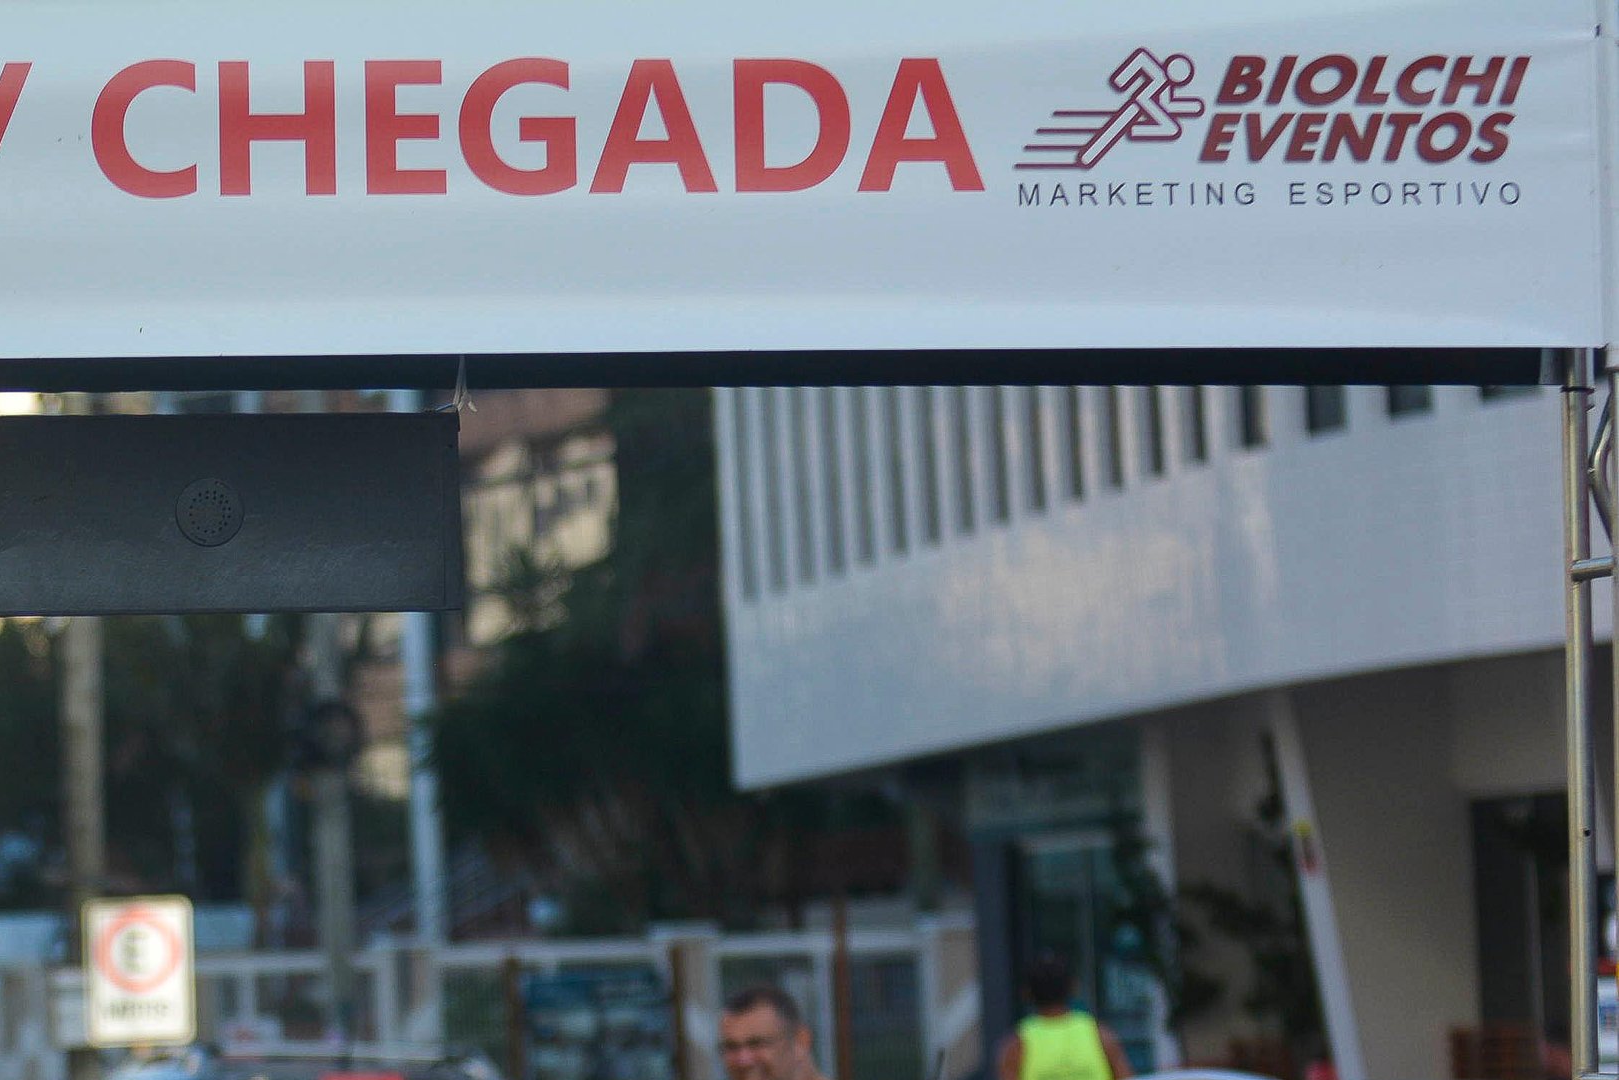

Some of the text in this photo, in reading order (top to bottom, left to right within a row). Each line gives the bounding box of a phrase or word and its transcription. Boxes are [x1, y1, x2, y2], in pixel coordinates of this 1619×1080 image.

[1217, 54, 1531, 104] BIOLCHI
[90, 57, 987, 198] CHEGADA
[1200, 112, 1514, 162] EVENTOS
[1017, 181, 1521, 206] MARKETING ESPORTIVO
